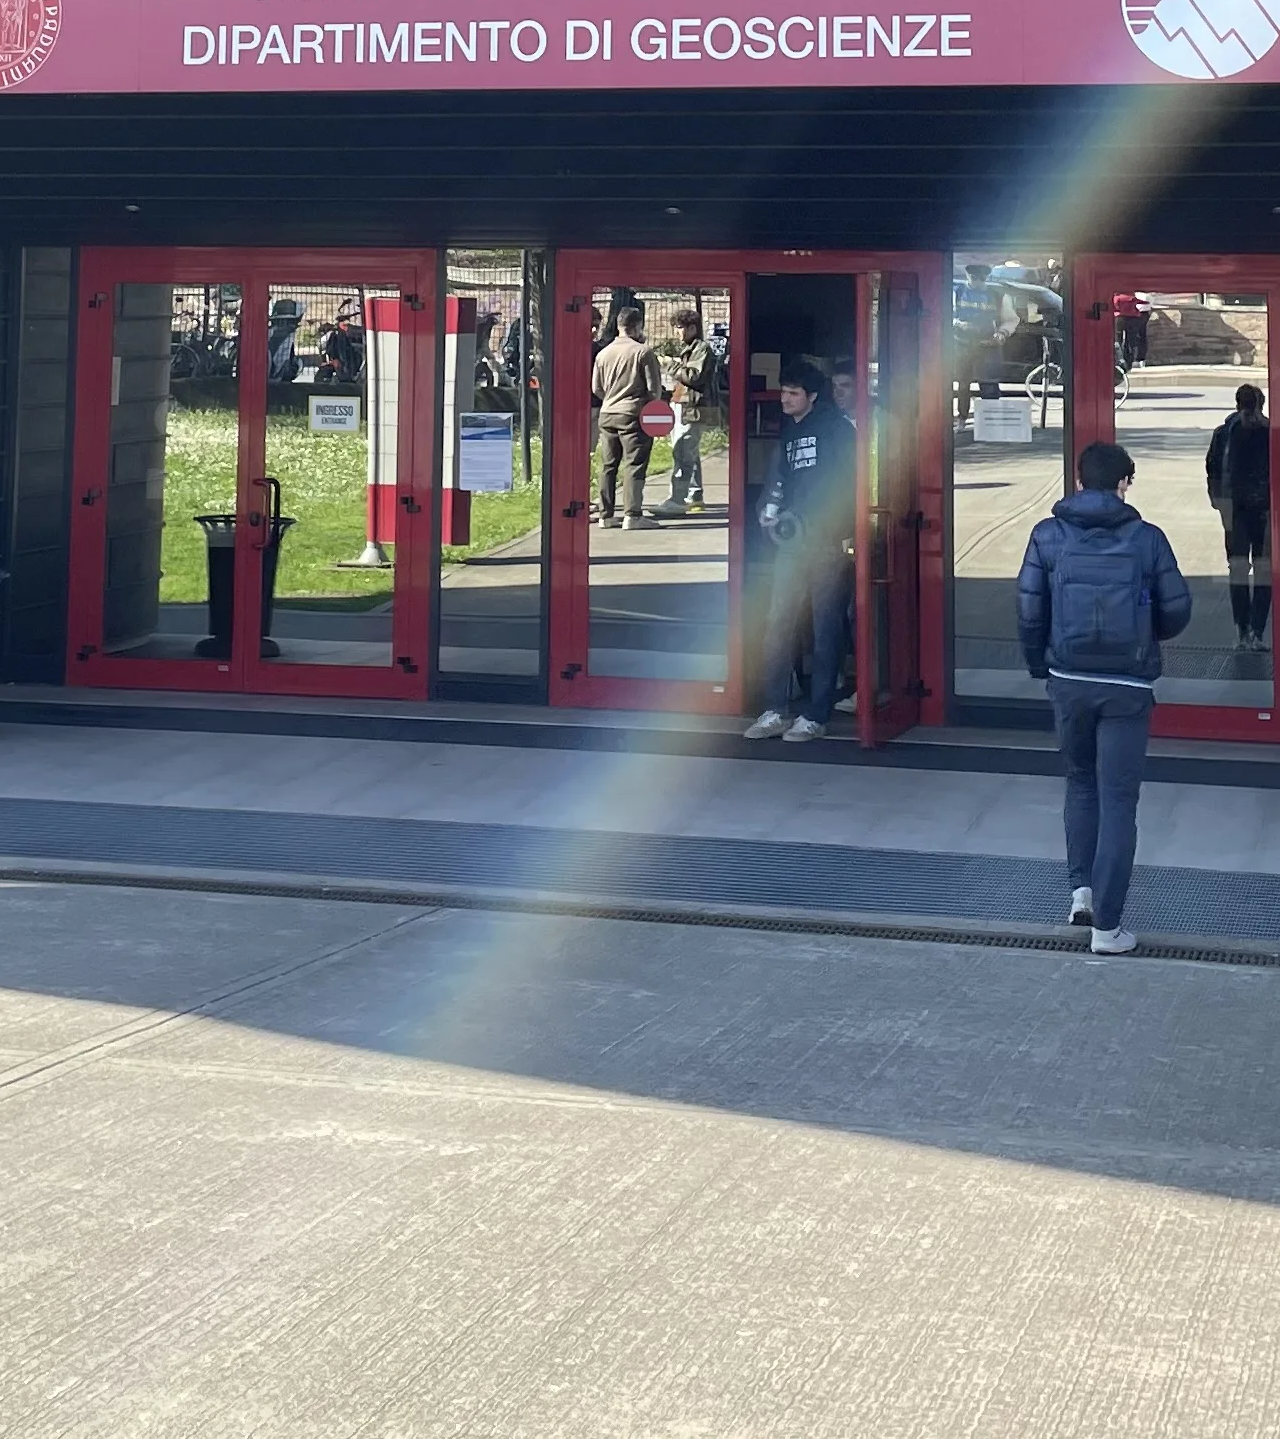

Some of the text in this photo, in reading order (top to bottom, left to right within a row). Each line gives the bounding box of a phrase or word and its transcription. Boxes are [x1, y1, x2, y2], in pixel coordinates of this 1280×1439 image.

[182, 14, 973, 66] DIPARTIMENTO DI GEOSCIENZE
